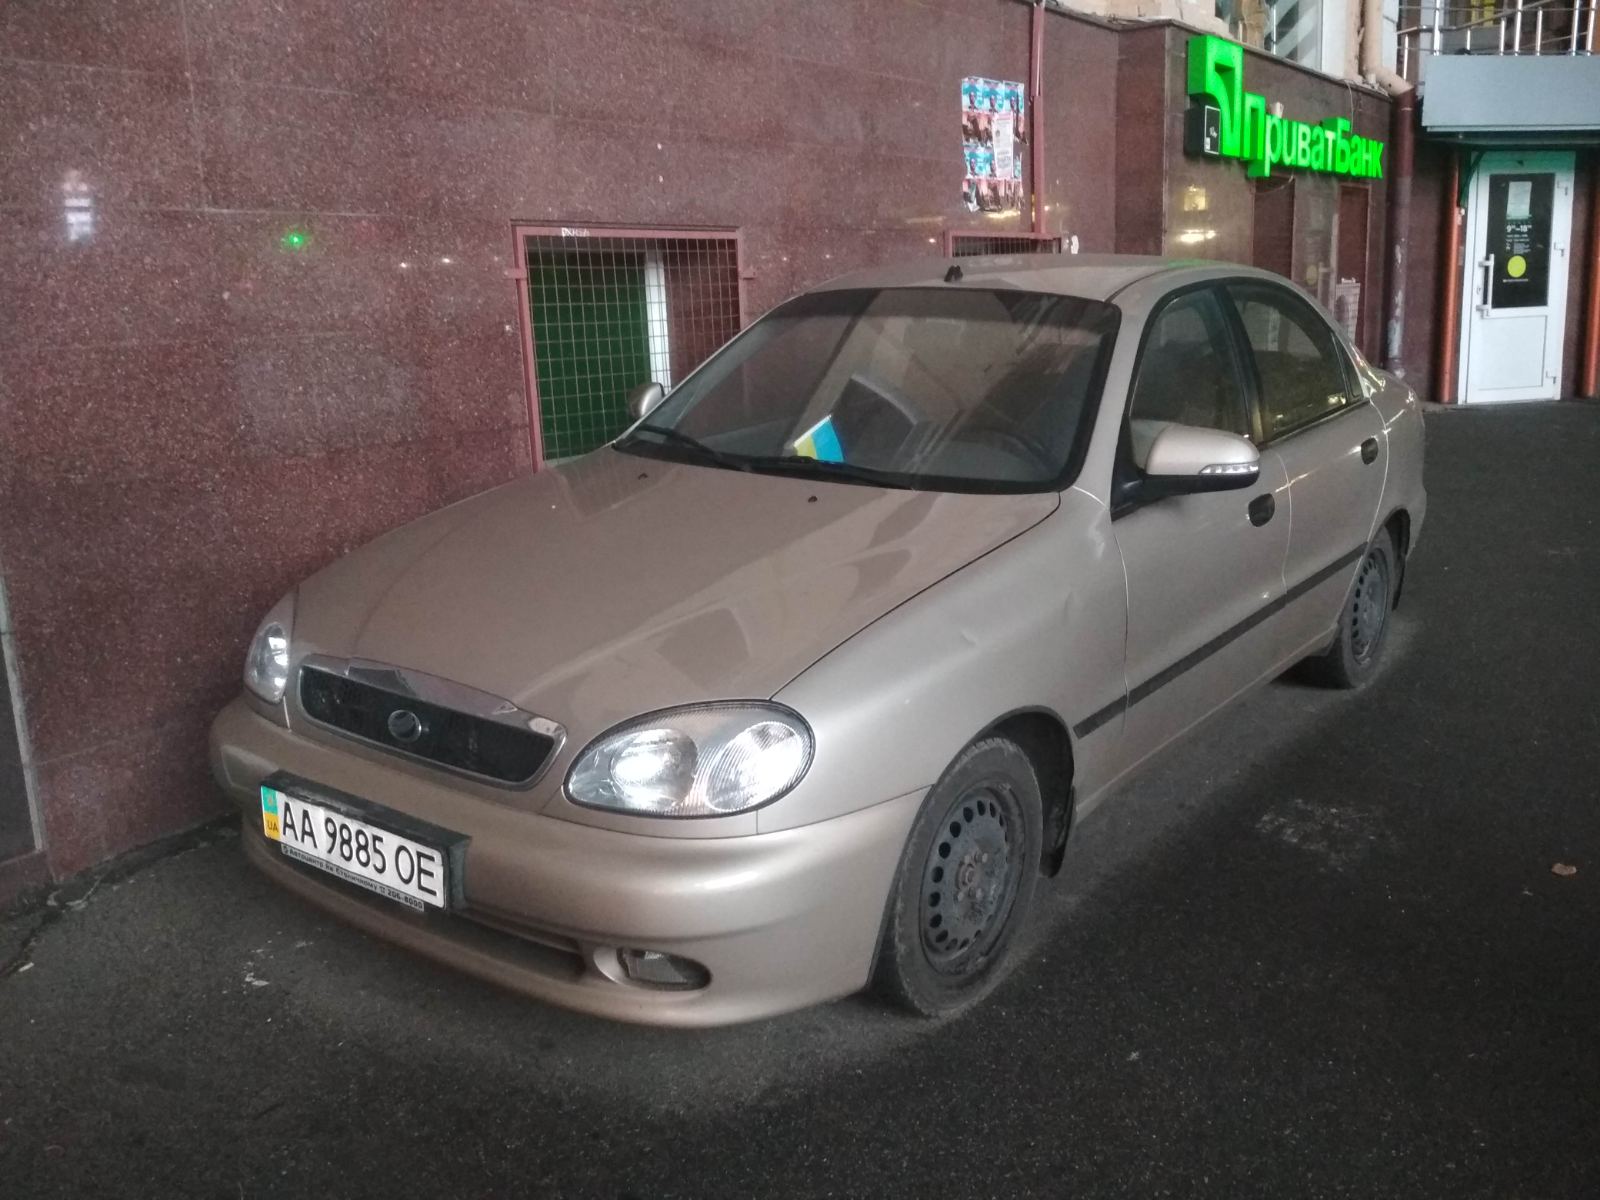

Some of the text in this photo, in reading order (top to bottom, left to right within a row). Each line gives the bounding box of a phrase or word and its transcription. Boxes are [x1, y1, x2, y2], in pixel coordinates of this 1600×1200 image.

[1244, 92, 1385, 179] ПриватБанк
[267, 820, 279, 833] UA
[282, 801, 438, 897] AA 9885 OE
